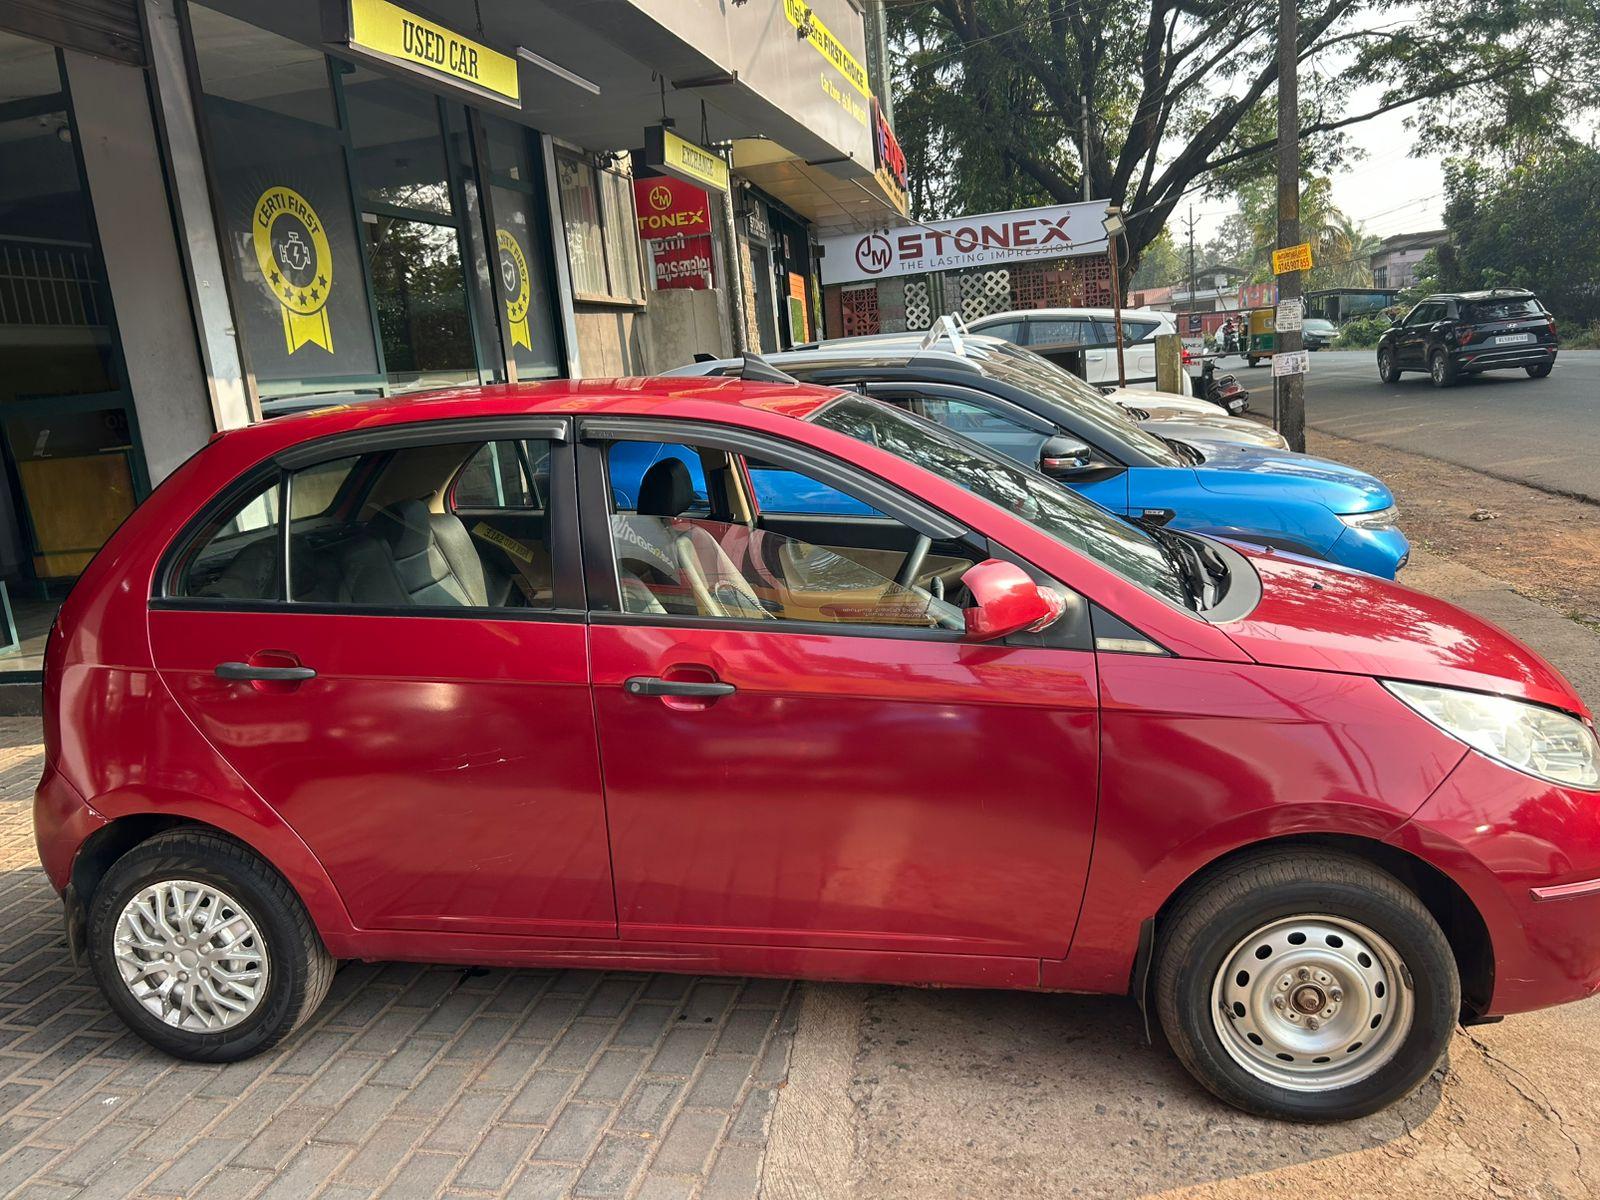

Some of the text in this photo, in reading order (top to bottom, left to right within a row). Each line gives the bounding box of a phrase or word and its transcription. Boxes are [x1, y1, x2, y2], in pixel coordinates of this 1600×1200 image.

[402, 19, 479, 79] USED CAR
[824, 33, 843, 66] FIRST
[258, 193, 321, 235] CERTI FIRST
[639, 208, 705, 231] TONEX
[897, 215, 1072, 260] STONEX
[899, 241, 1075, 271] THE LASTING IMPRESSION
